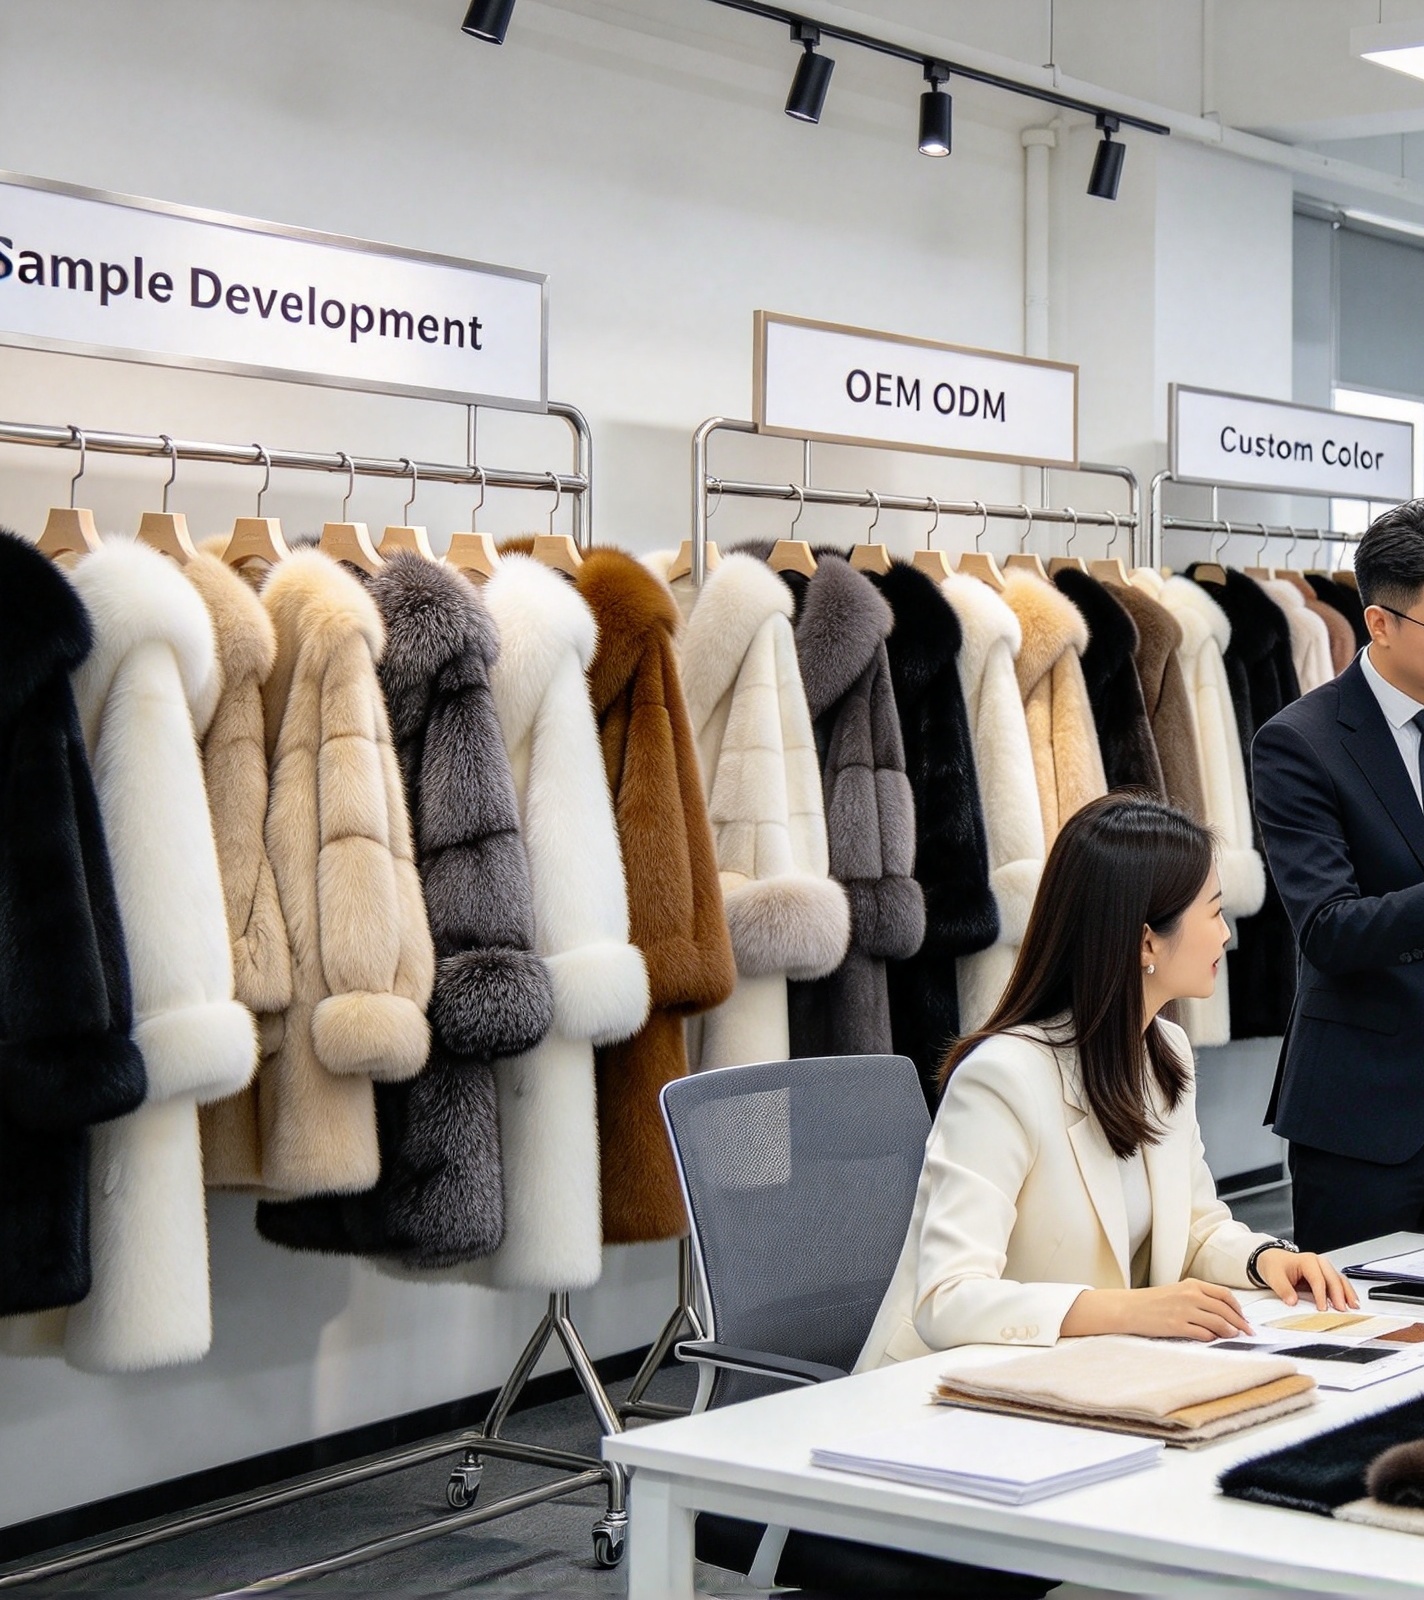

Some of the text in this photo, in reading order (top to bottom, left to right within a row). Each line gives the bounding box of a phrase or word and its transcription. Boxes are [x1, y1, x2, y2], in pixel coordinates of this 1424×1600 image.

[190, 267, 483, 351] Development
[845, 368, 1006, 423] OEM ODM
[1220, 425, 1385, 471] Custom Color
